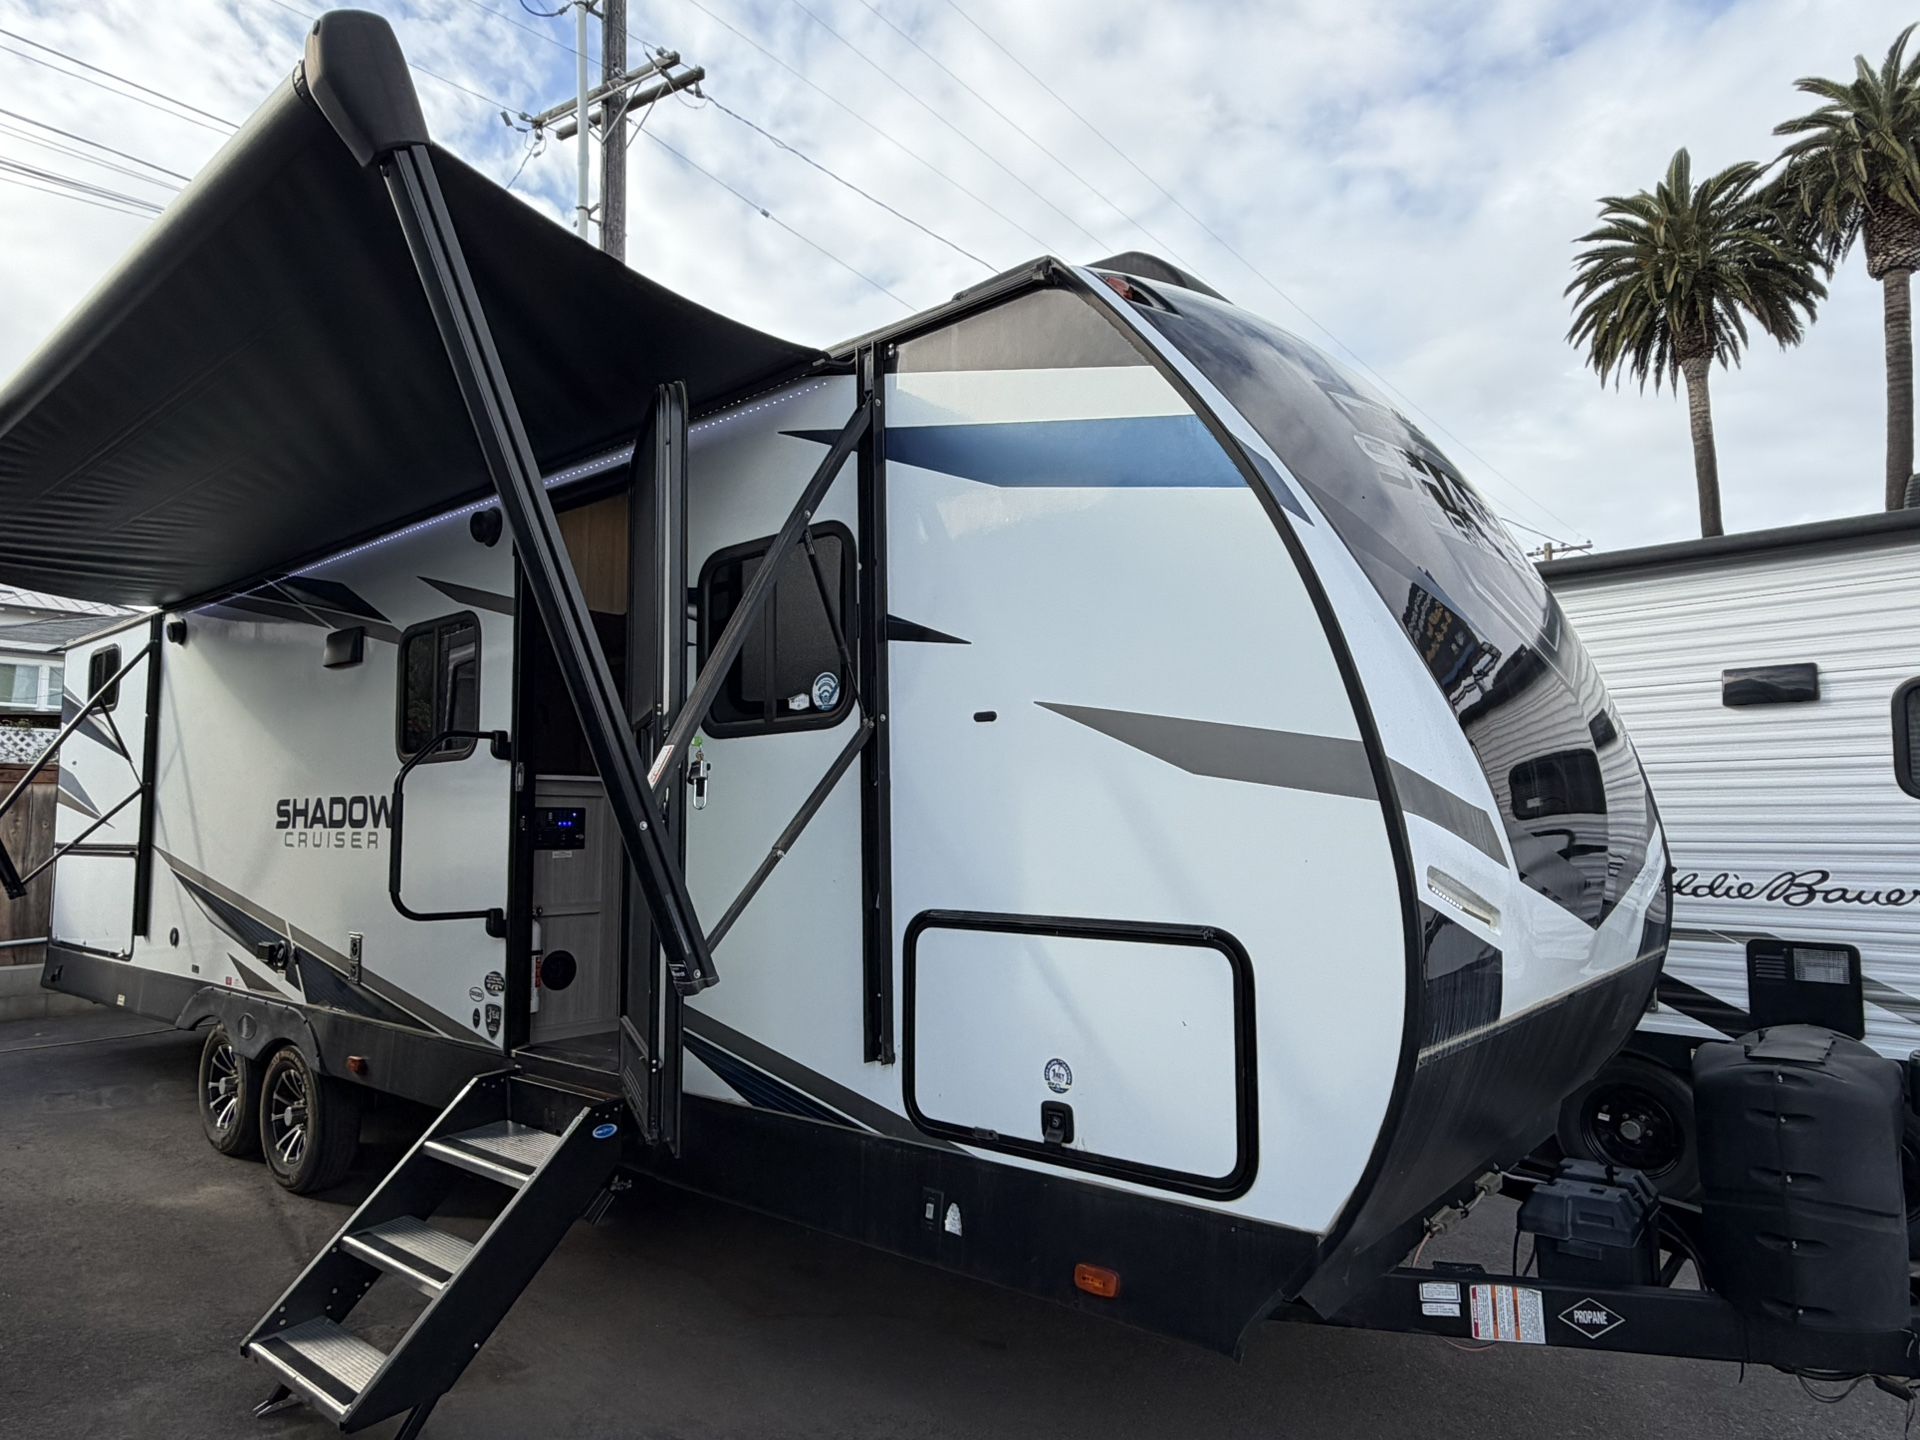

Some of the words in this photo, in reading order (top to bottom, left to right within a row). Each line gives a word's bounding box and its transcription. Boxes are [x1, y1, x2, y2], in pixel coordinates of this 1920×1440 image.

[275, 795, 393, 829] SHADOW
[284, 831, 379, 849] CRUISER
[1672, 866, 1756, 899] ddie
[1573, 1310, 1608, 1325] PROPANE
